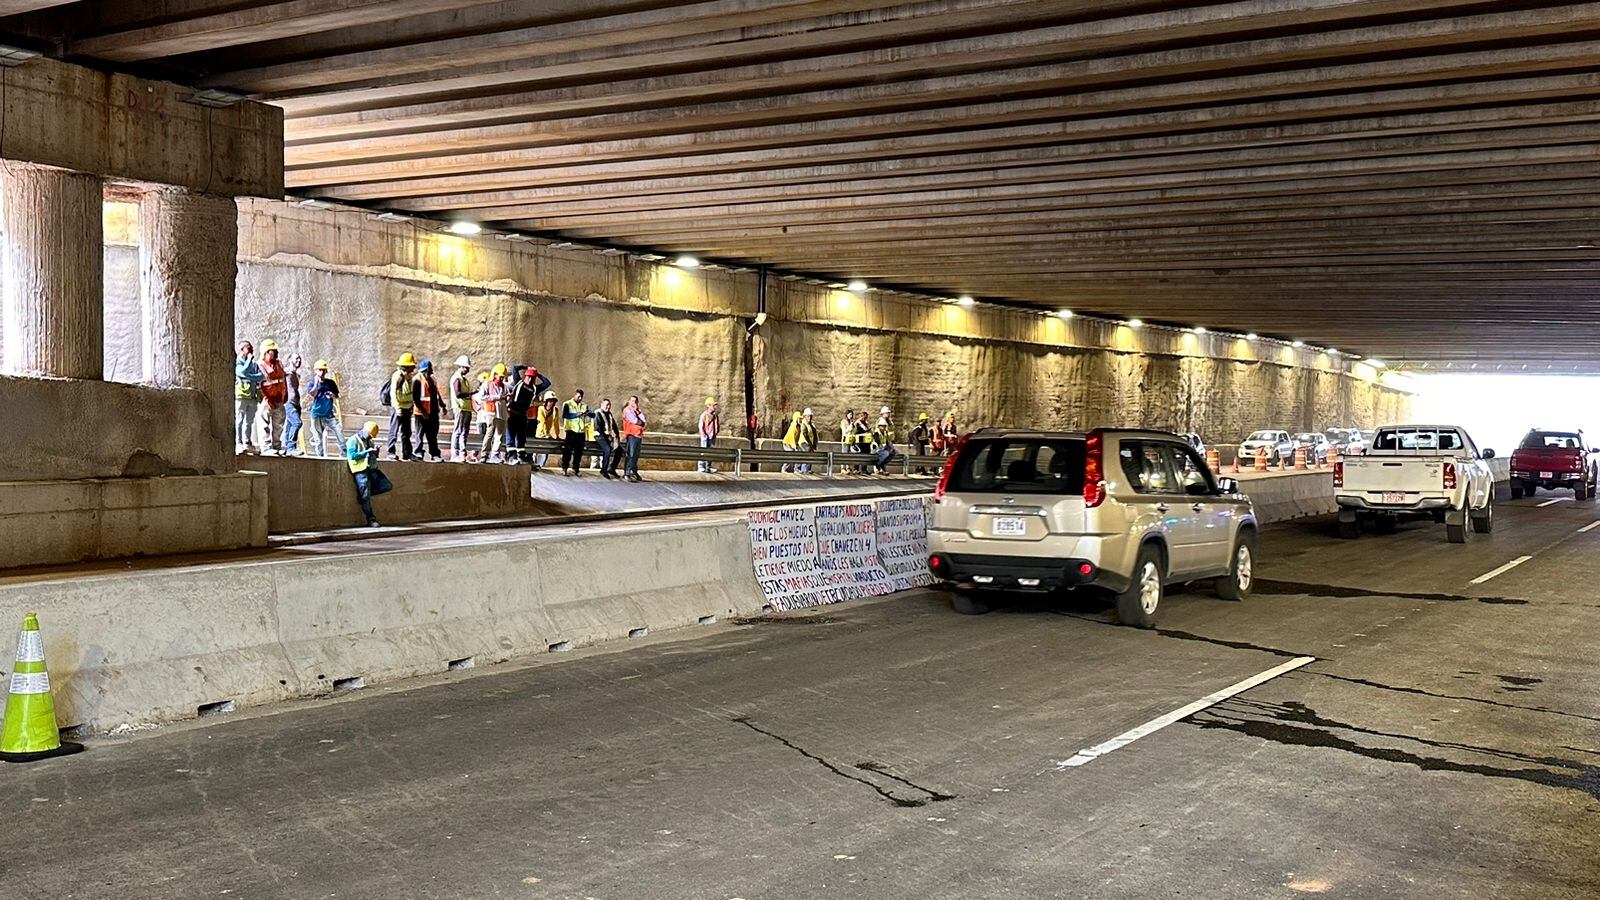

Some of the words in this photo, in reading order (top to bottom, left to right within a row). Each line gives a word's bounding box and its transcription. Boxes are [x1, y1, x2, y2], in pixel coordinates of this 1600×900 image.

[751, 527, 773, 542] TIENE
[773, 526, 788, 541] LOS
[788, 525, 813, 540] HUEVOS
[752, 546, 768, 560] BIEN
[769, 542, 802, 558] PUESTOS
[803, 541, 815, 555] NO
[831, 538, 853, 554] CHAVEZ
[854, 537, 864, 552] EN
[865, 538, 871, 551] 4
[754, 564, 764, 577] LE
[764, 561, 786, 576] TIENE
[787, 558, 813, 573] MIEDO
[837, 556, 849, 570] LES
[760, 579, 787, 595] ESTAS
[785, 575, 814, 590] MAFIAS
[812, 572, 829, 588] QUE
